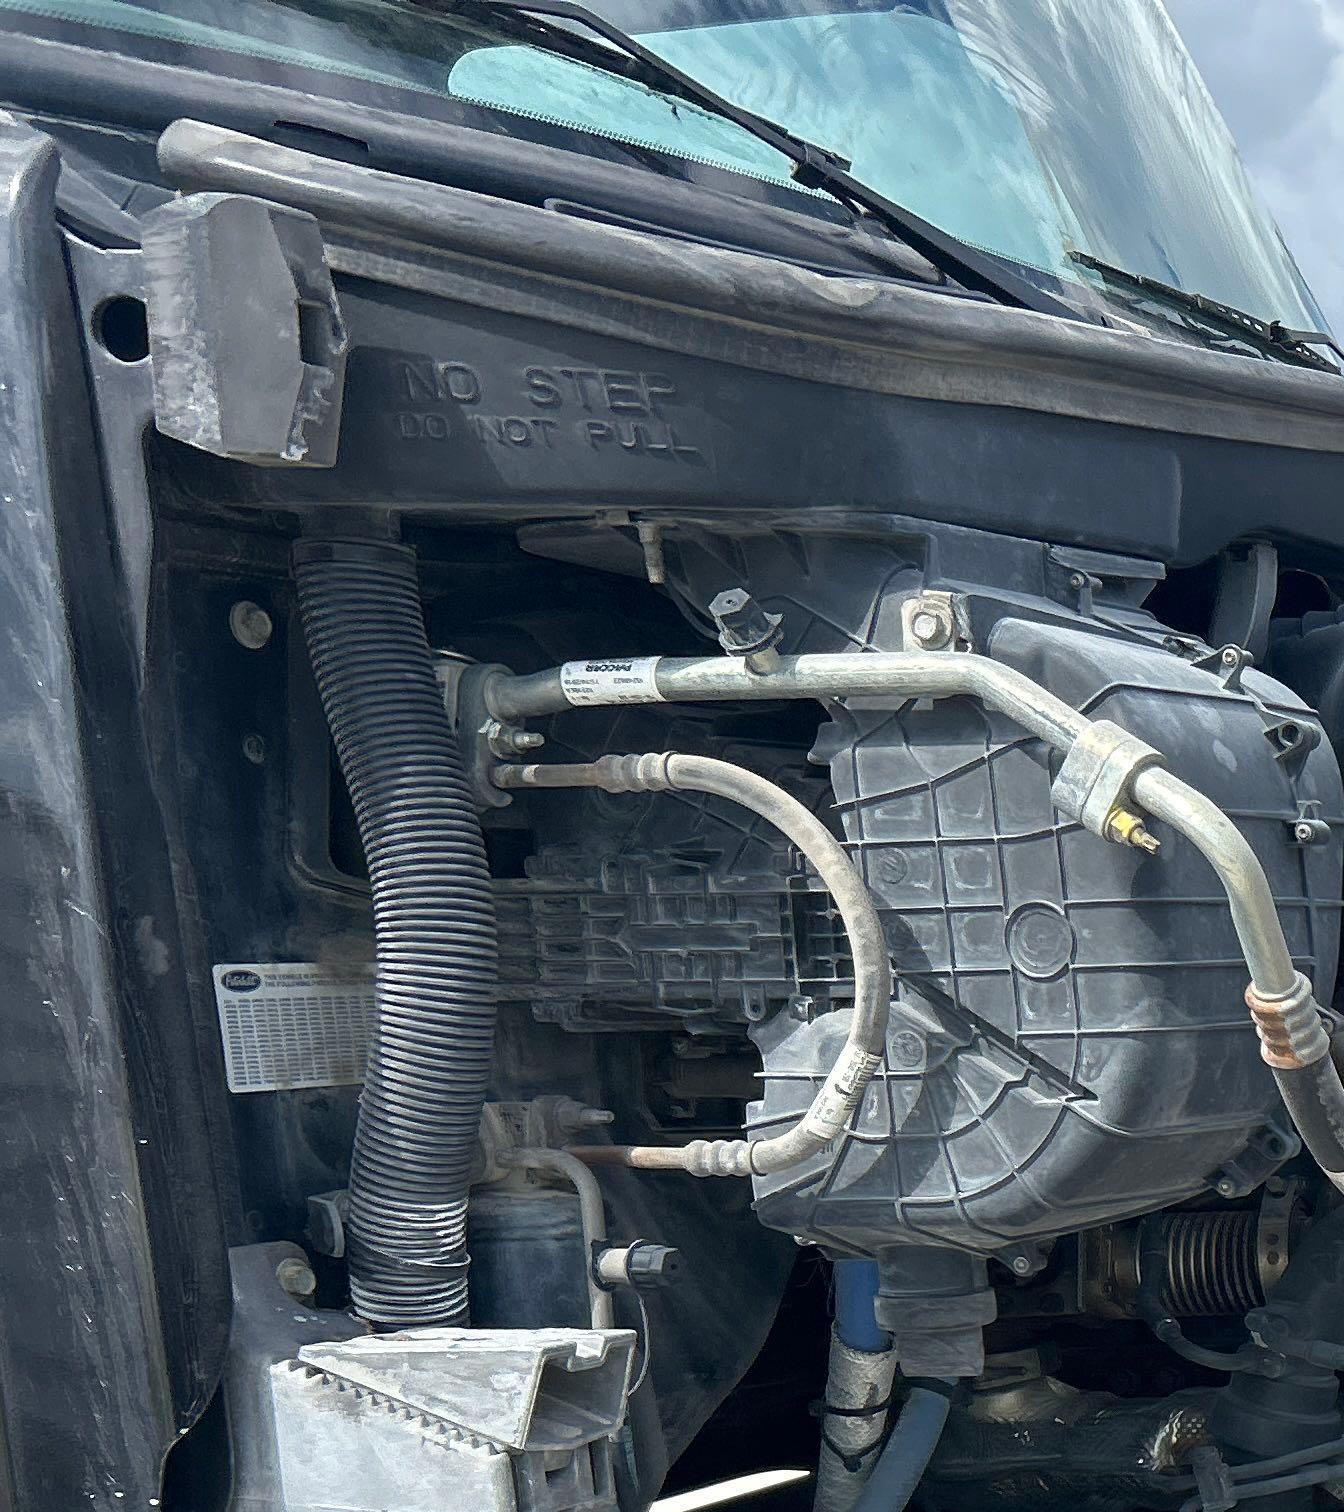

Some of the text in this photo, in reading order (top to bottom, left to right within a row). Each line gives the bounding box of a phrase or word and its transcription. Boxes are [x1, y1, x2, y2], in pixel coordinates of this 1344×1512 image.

[400, 361, 677, 415] NO STEP
[400, 412, 700, 451] DO NOT PULL
